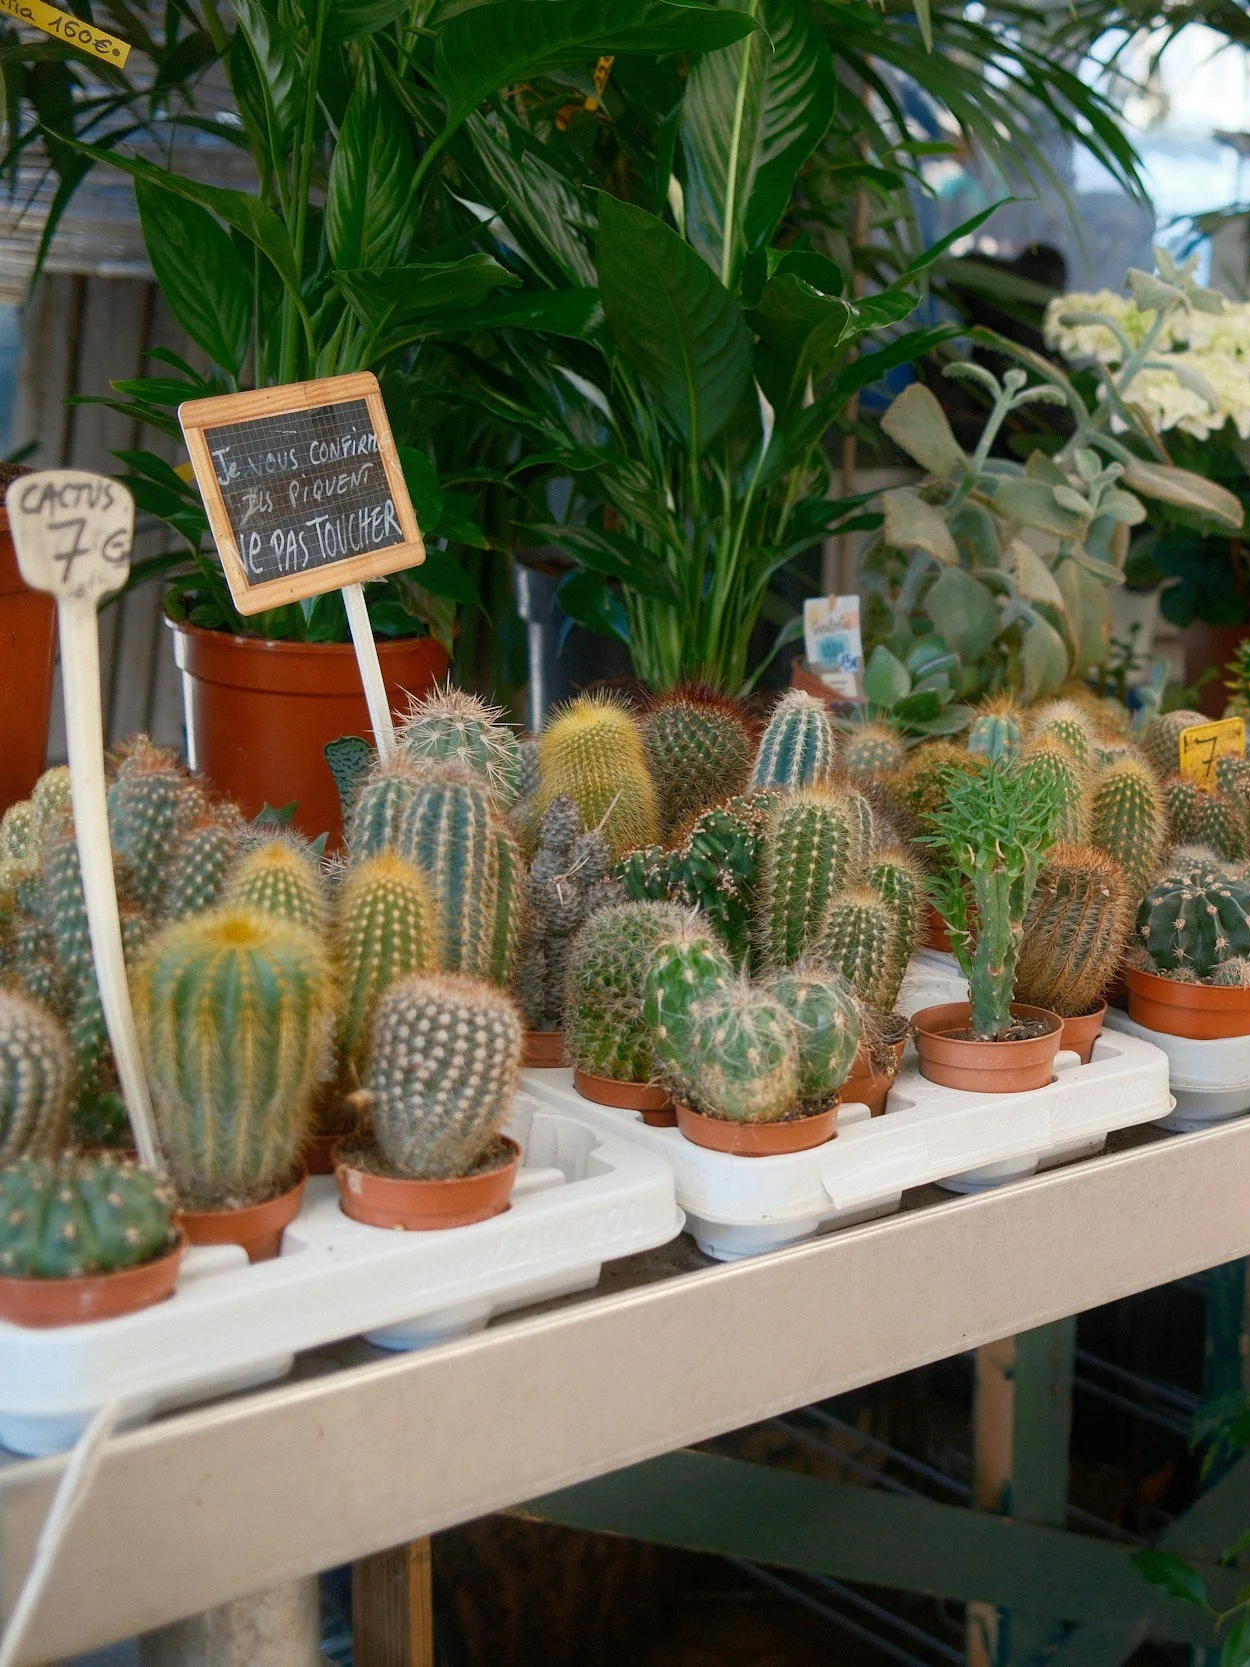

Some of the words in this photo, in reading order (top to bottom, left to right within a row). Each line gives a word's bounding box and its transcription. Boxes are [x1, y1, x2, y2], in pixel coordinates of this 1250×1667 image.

[211, 446, 241, 486] Je
[20, 482, 114, 517] CACTUS
[270, 528, 309, 572] PAS
[306, 499, 403, 559] TOUCHER
[1194, 735, 1218, 778] 7
